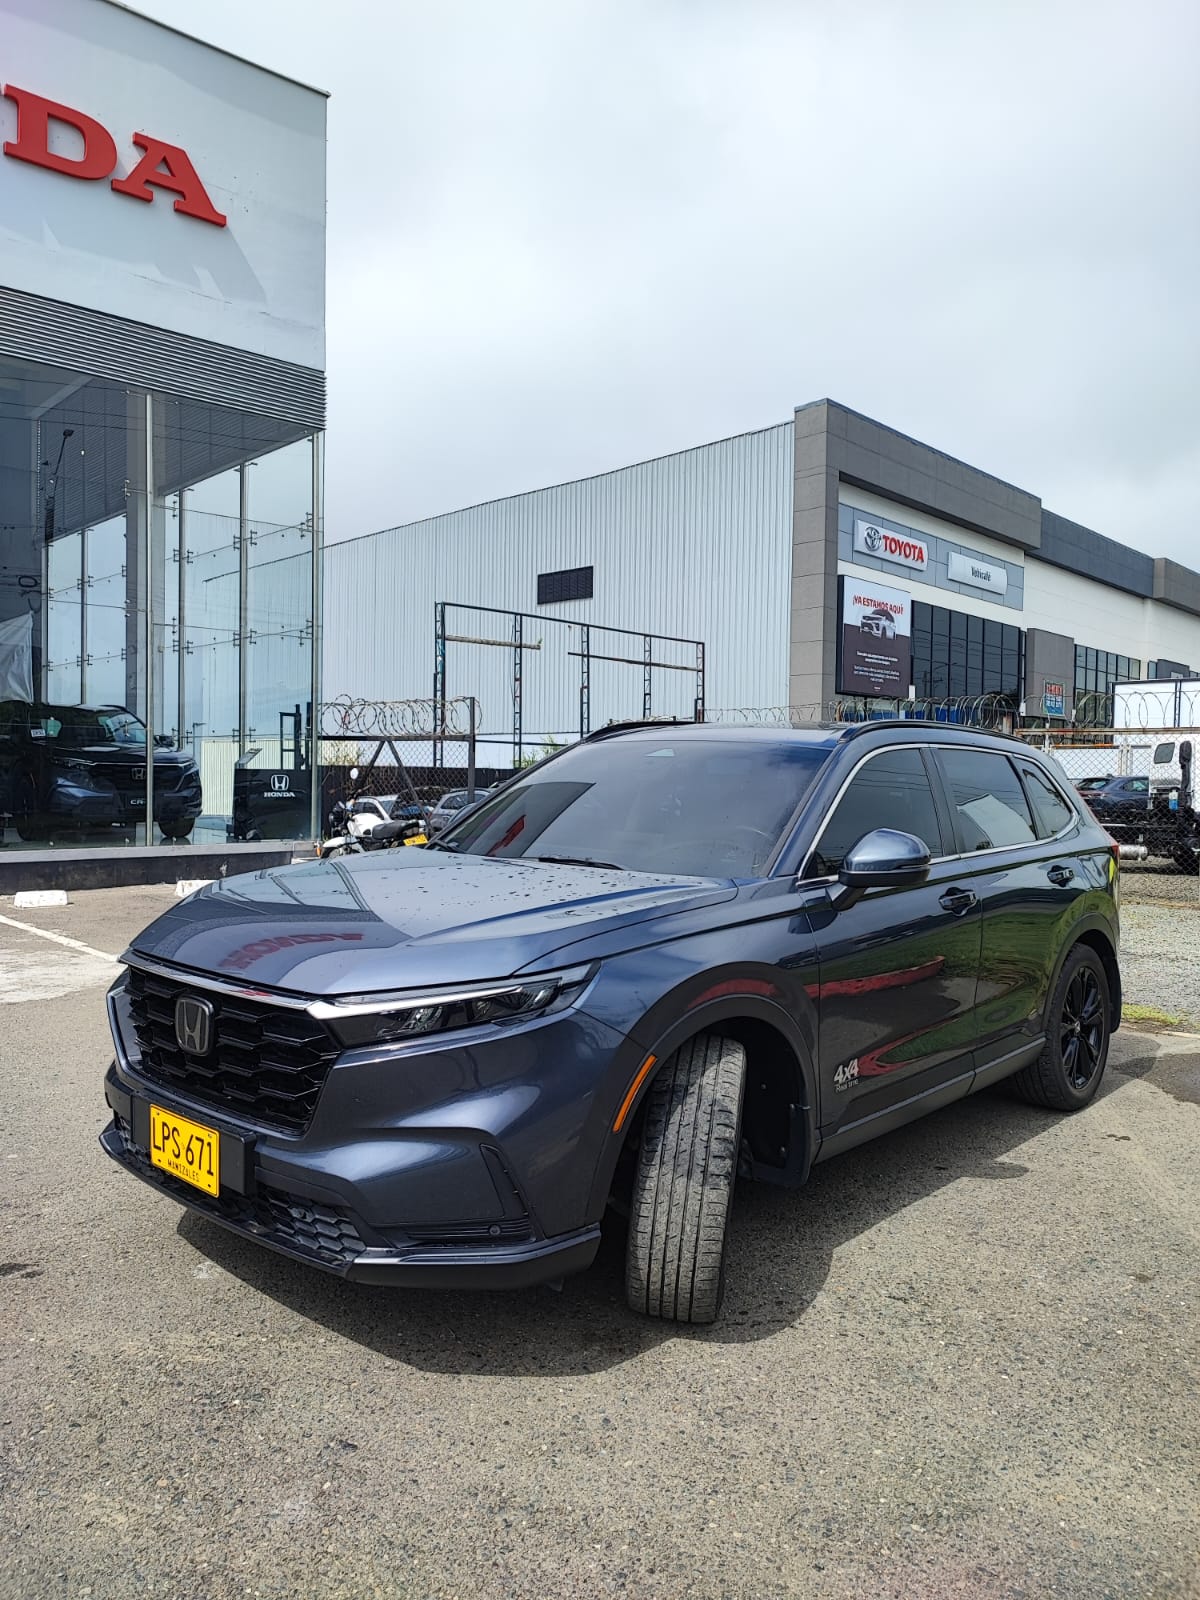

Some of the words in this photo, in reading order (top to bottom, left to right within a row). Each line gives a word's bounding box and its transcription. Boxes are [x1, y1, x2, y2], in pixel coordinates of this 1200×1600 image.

[882, 534, 925, 563] TOYOTA
[863, 597, 889, 610] ESTAMOS
[152, 1117, 181, 1159] LPS
[185, 1134, 214, 1176] 671
[167, 1158, 200, 1182] MANIZALES
